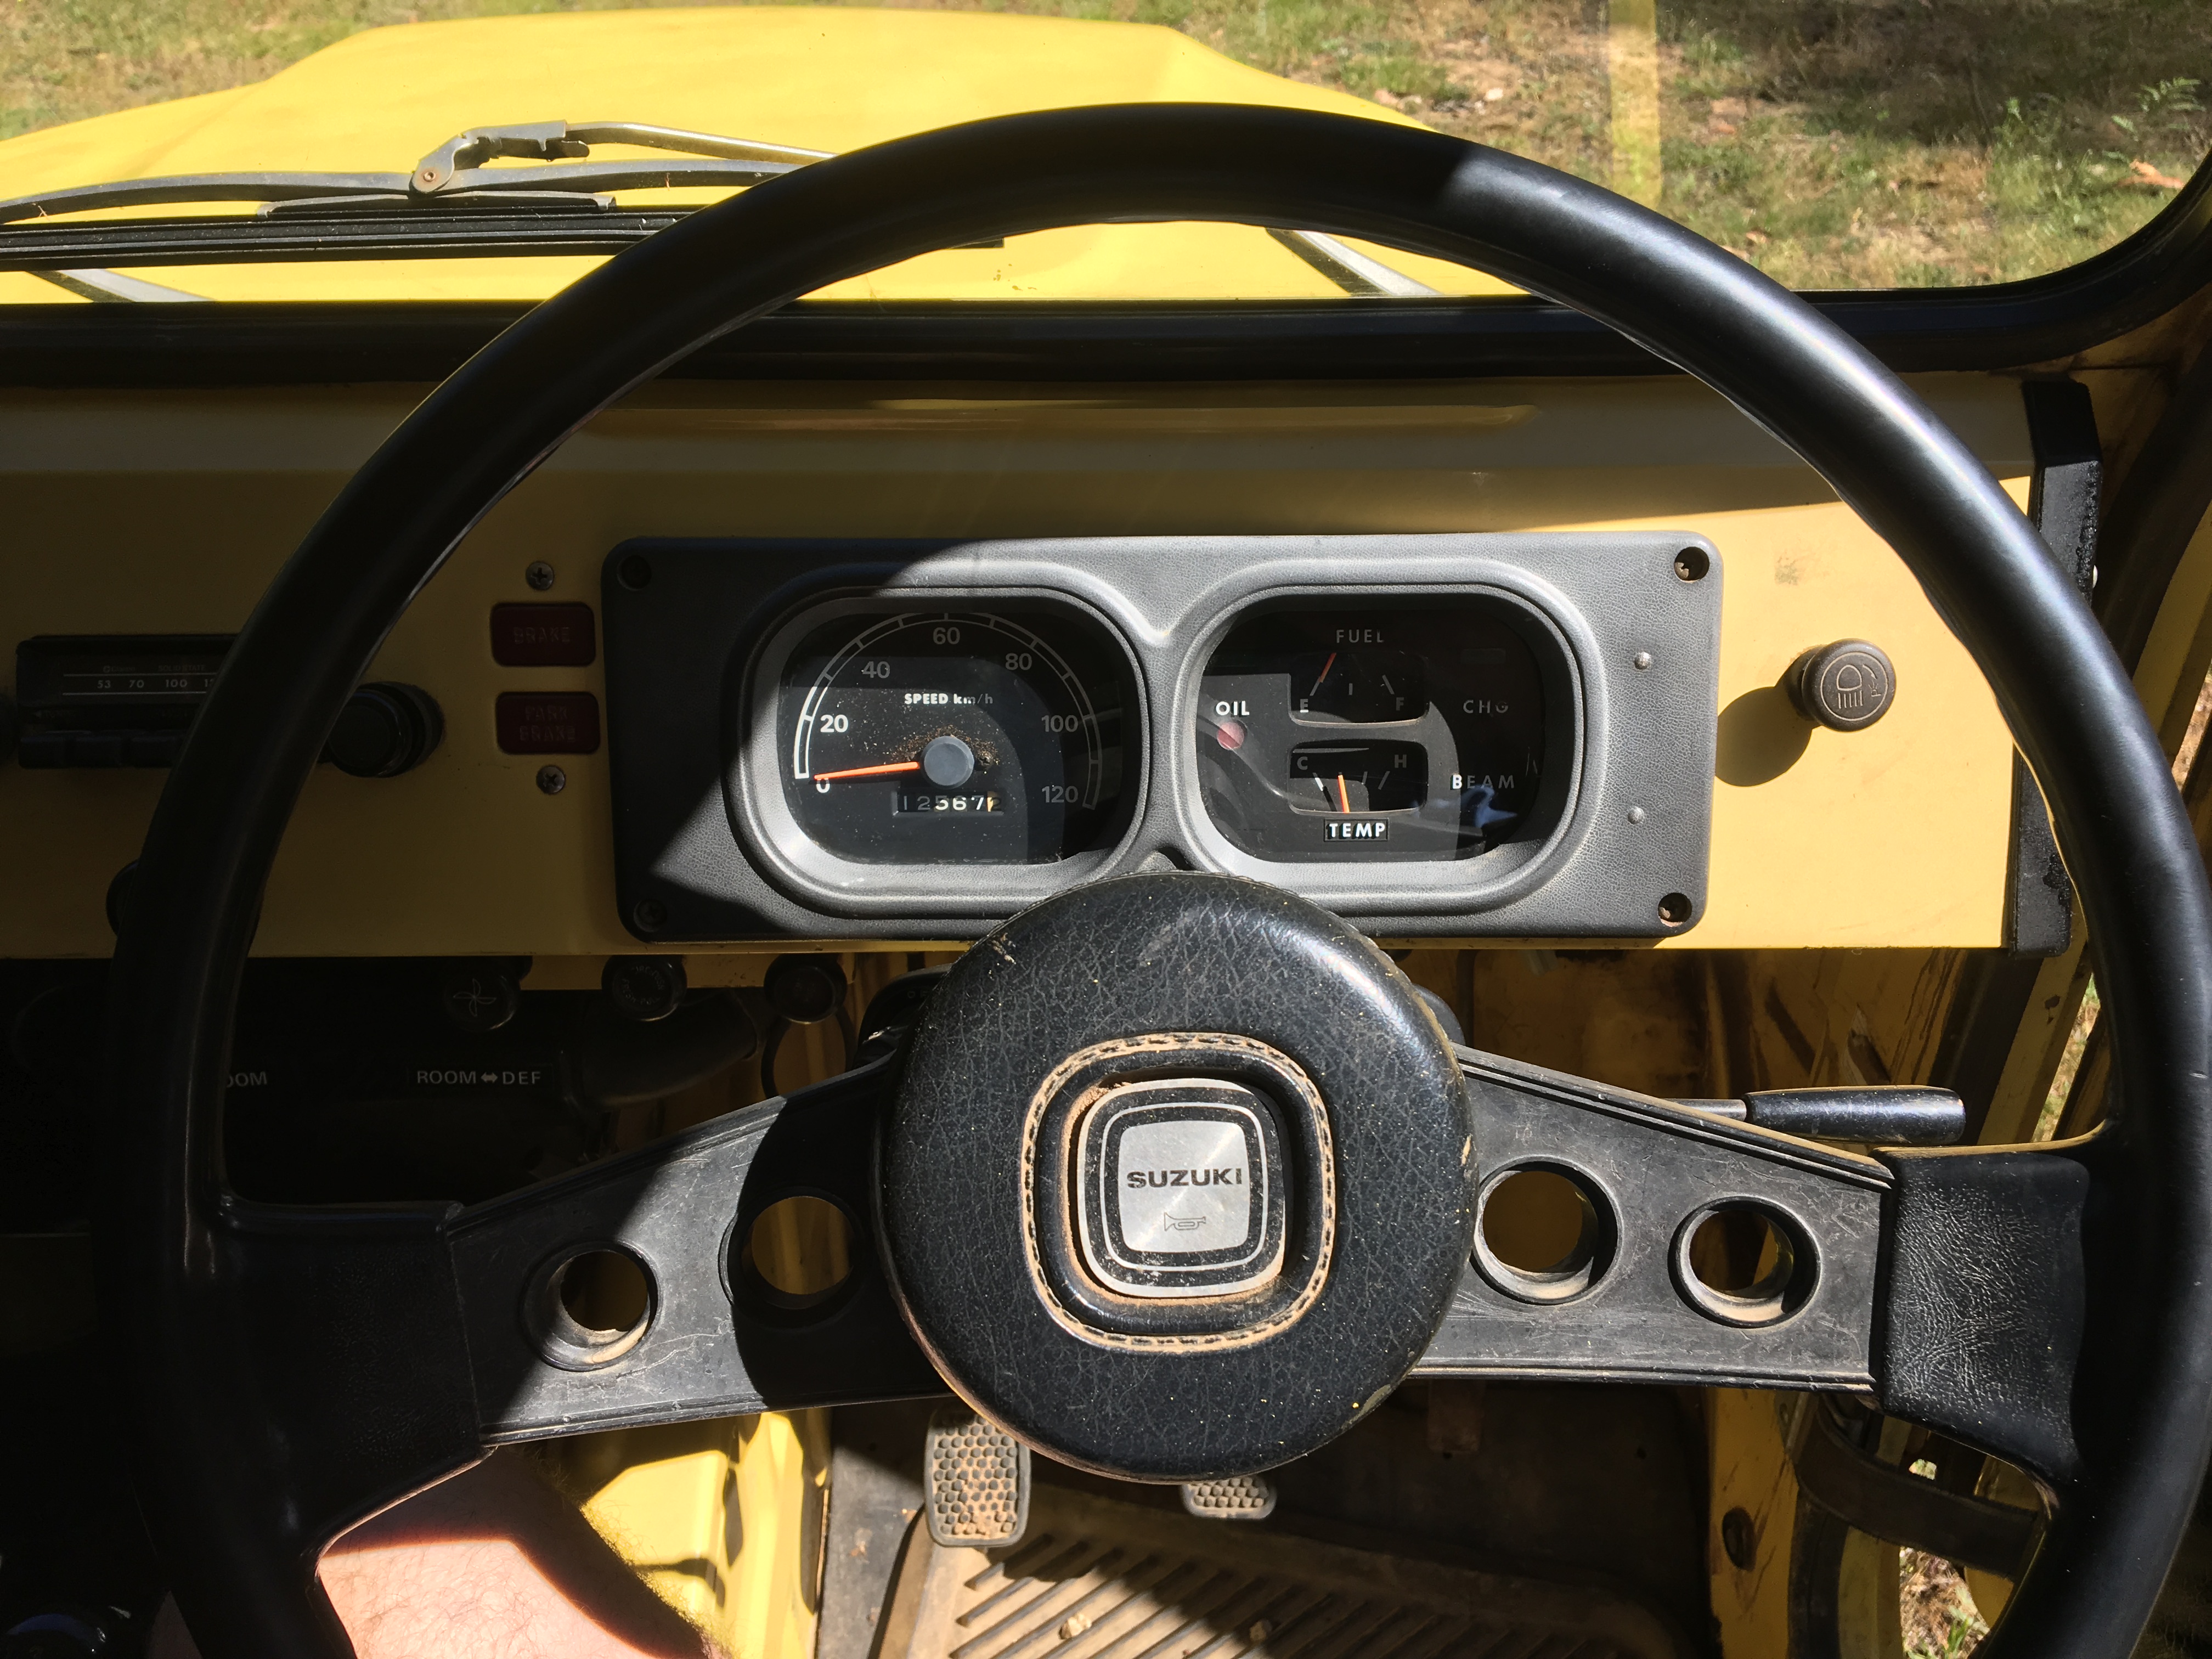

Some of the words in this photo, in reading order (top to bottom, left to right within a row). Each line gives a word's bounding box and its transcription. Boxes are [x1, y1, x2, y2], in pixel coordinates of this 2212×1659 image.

[513, 627, 571, 645] BRAKE
[933, 627, 960, 644] 60
[1336, 629, 1384, 644] FUEL
[1005, 653, 1032, 670] 80
[862, 661, 890, 679] 40
[97, 680, 111, 689] 53
[128, 679, 145, 689] 70
[165, 679, 188, 688] 100
[904, 693, 948, 704] SPEED
[953, 693, 993, 704] km/h
[1300, 699, 1308, 712] E
[1396, 697, 1404, 710] F
[1215, 701, 1250, 715] OIL
[1463, 699, 1509, 714] CHG
[820, 715, 848, 732] 20
[1041, 715, 1079, 732] 100
[520, 725, 576, 742] BRAKE
[1297, 757, 1308, 769] C
[1395, 755, 1407, 768] H
[816, 779, 830, 793] 0
[1452, 775, 1515, 789] BEAM
[1041, 786, 1079, 803] 120
[1329, 823, 1385, 837] TEMP
[226, 1071, 268, 1088] OM
[416, 1070, 477, 1085] ROOM
[503, 1071, 541, 1085] DEF
[1126, 1167, 1243, 1189] SUZUKI
